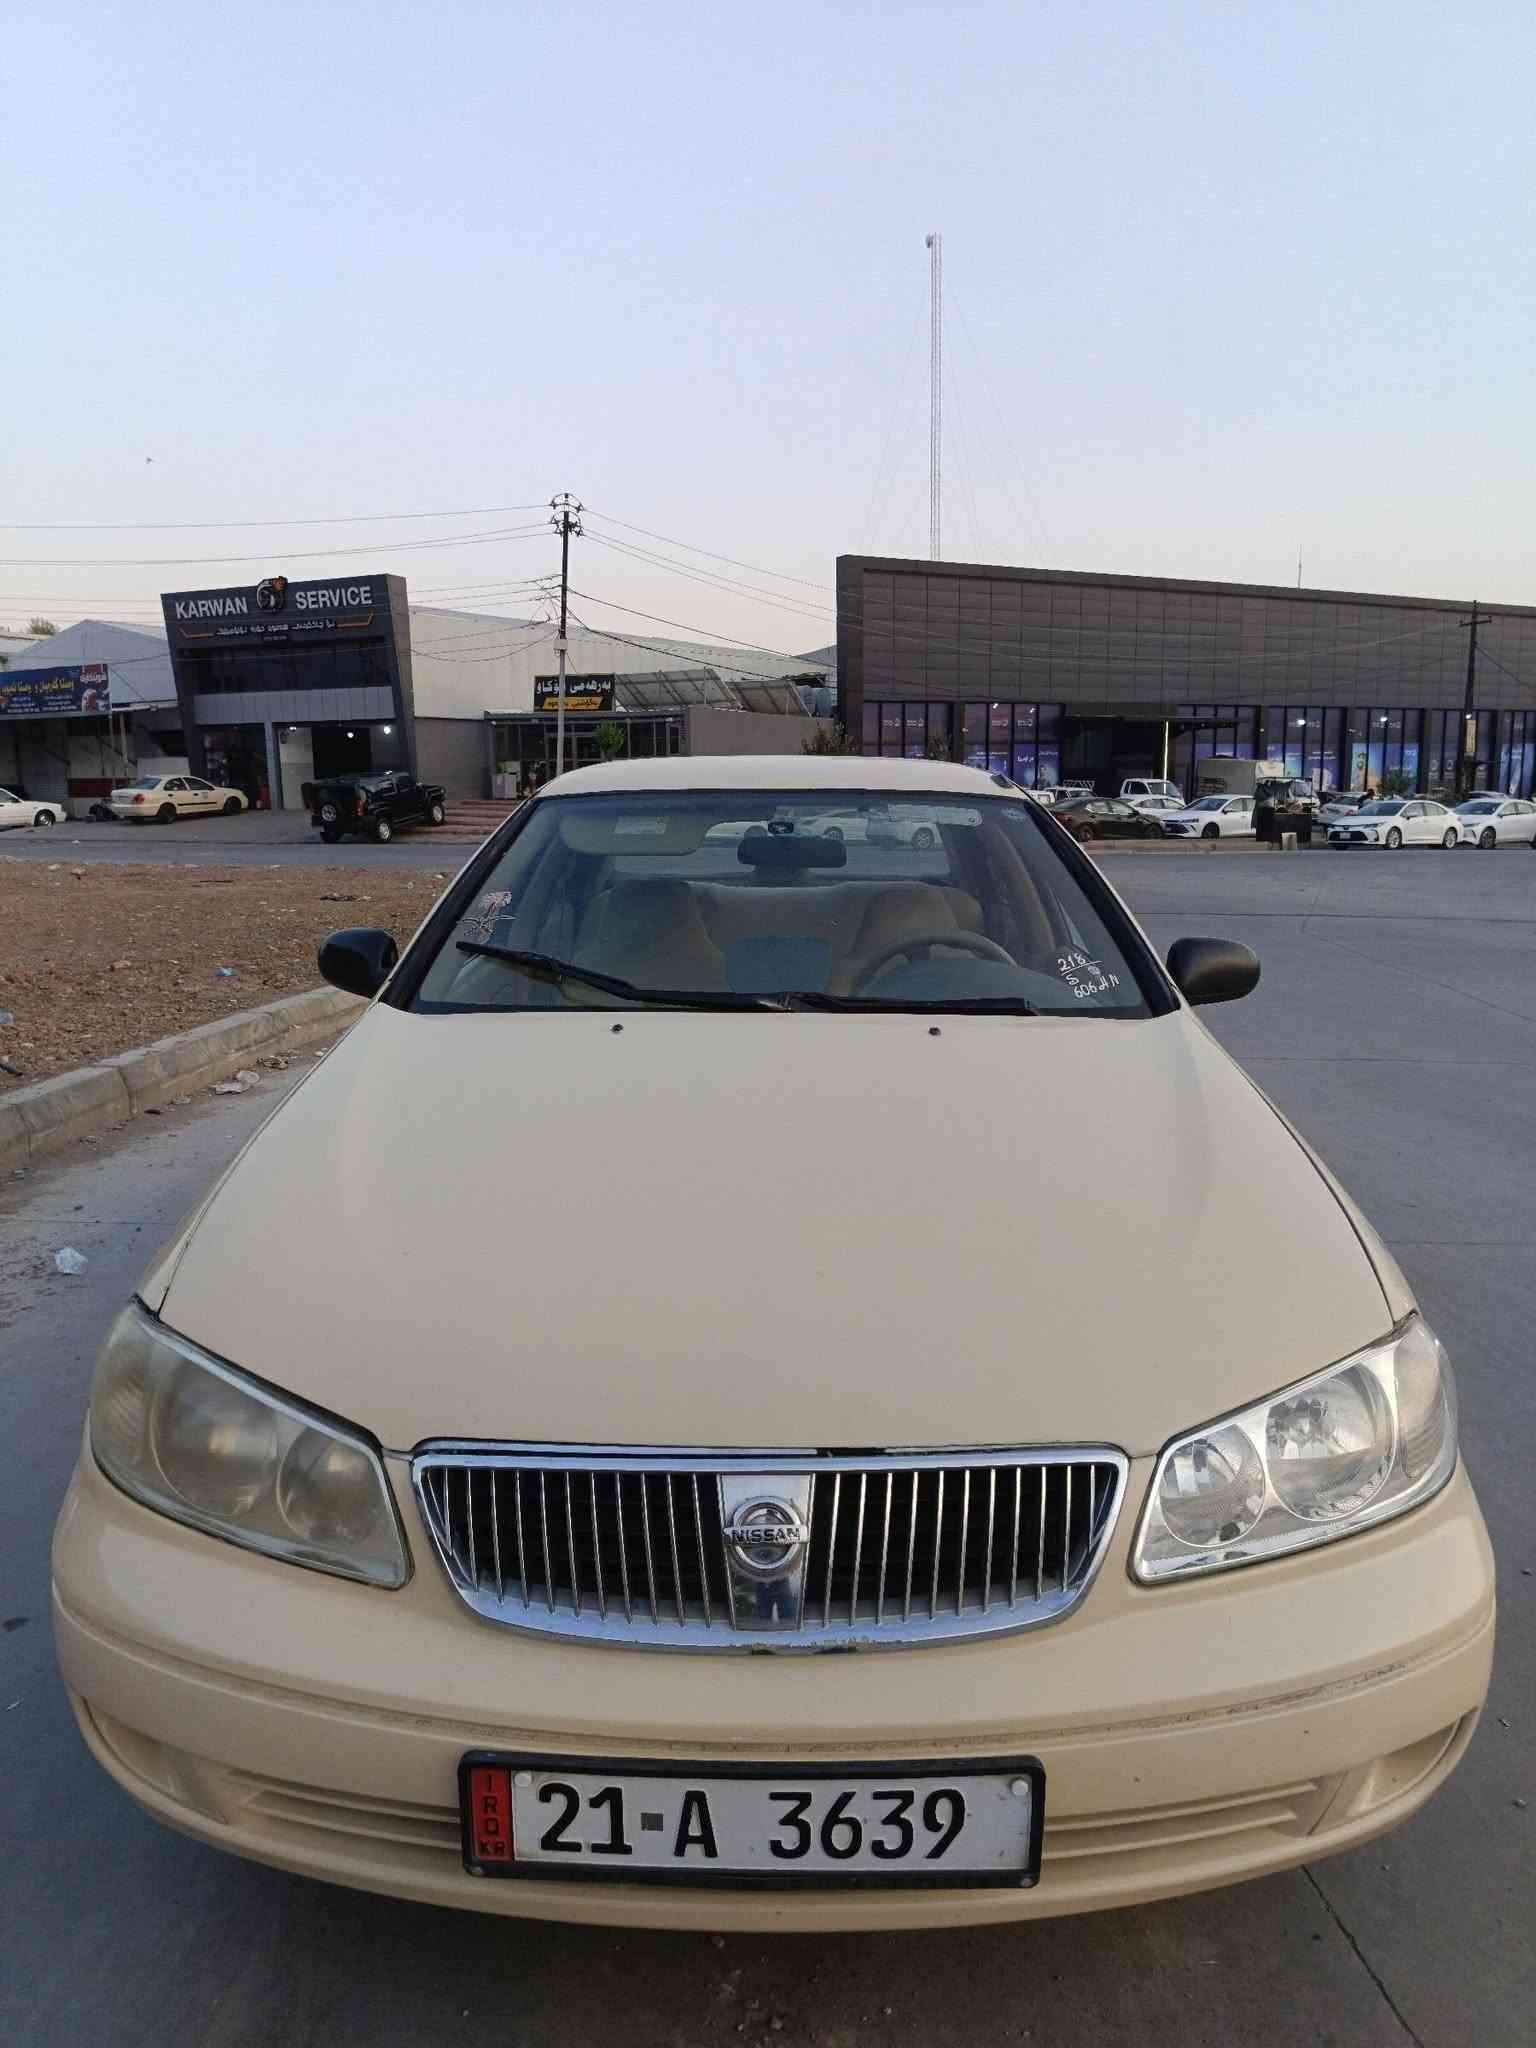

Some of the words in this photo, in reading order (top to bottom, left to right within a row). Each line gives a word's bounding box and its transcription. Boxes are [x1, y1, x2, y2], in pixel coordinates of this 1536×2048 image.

[175, 596, 248, 619] KARWAN
[295, 586, 373, 609] SERVICE
[731, 1526, 801, 1543] NISSAN
[768, 1787, 967, 1860] 3639
